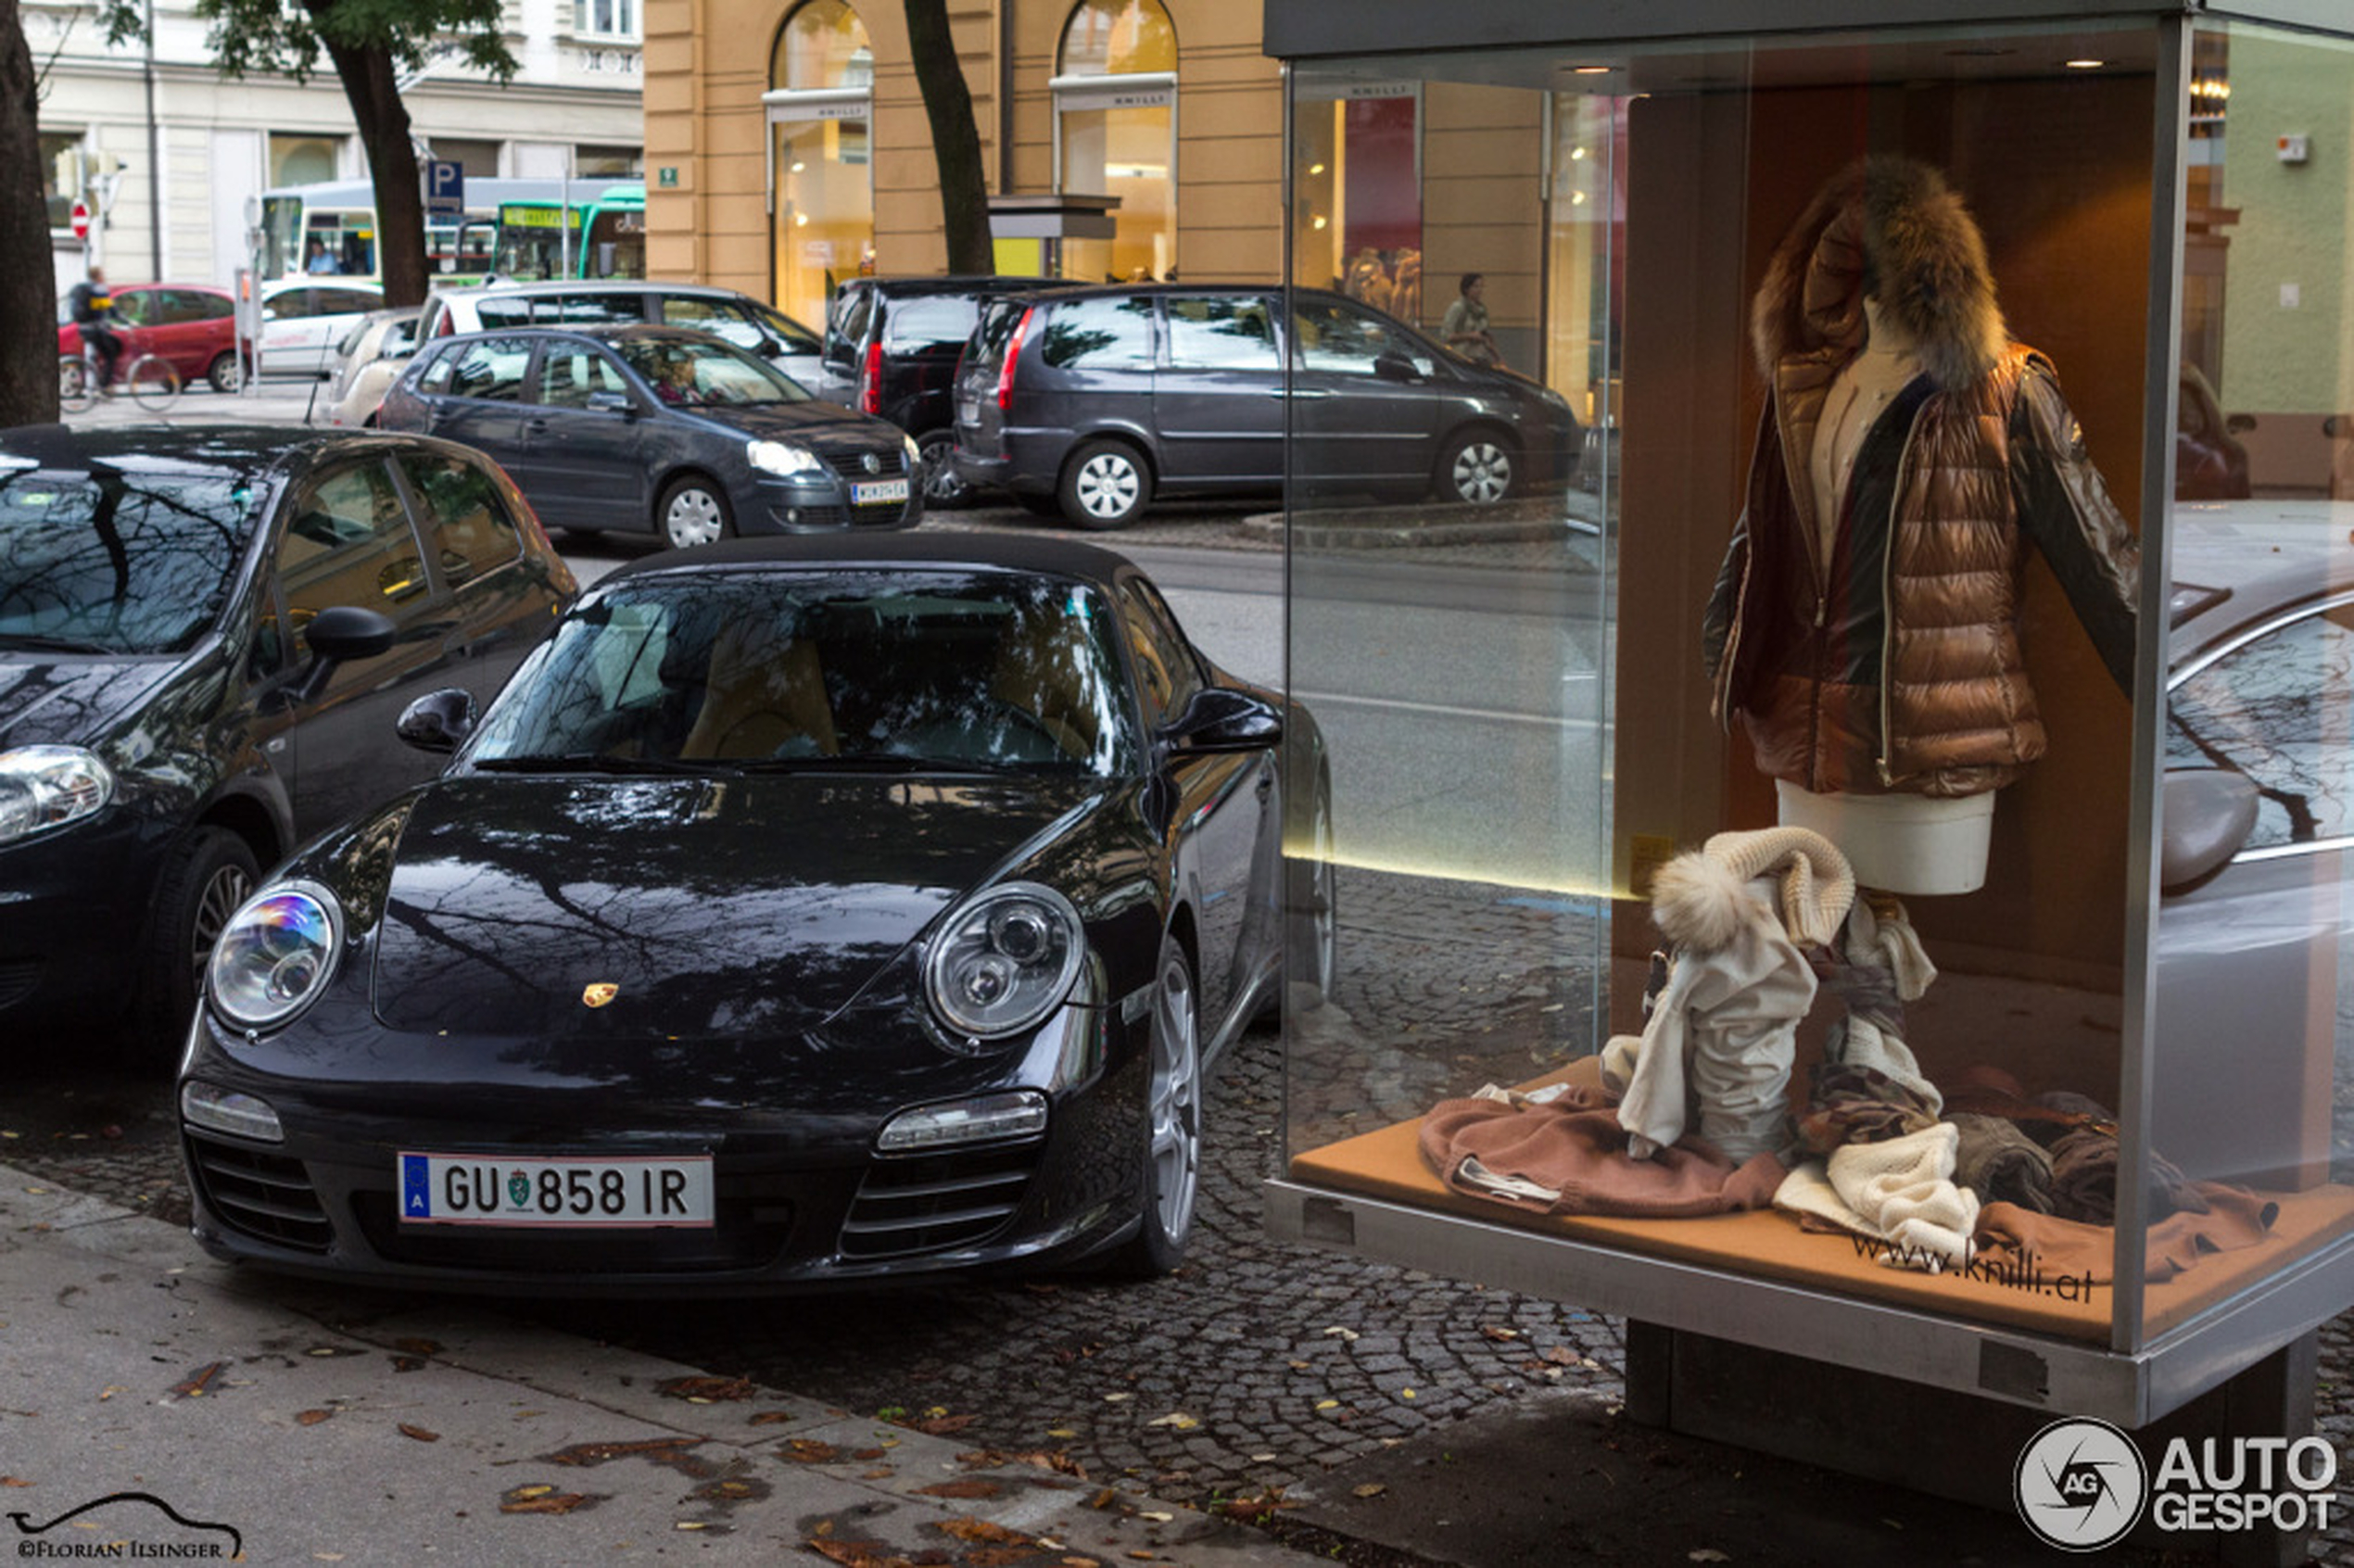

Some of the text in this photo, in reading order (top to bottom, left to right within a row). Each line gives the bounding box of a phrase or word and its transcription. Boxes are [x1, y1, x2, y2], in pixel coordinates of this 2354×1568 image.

[434, 163, 456, 195] P
[411, 1194, 424, 1208] A
[445, 1165, 688, 1216] GU 858 IR
[1852, 1233, 2095, 1304] www.knilli.at
